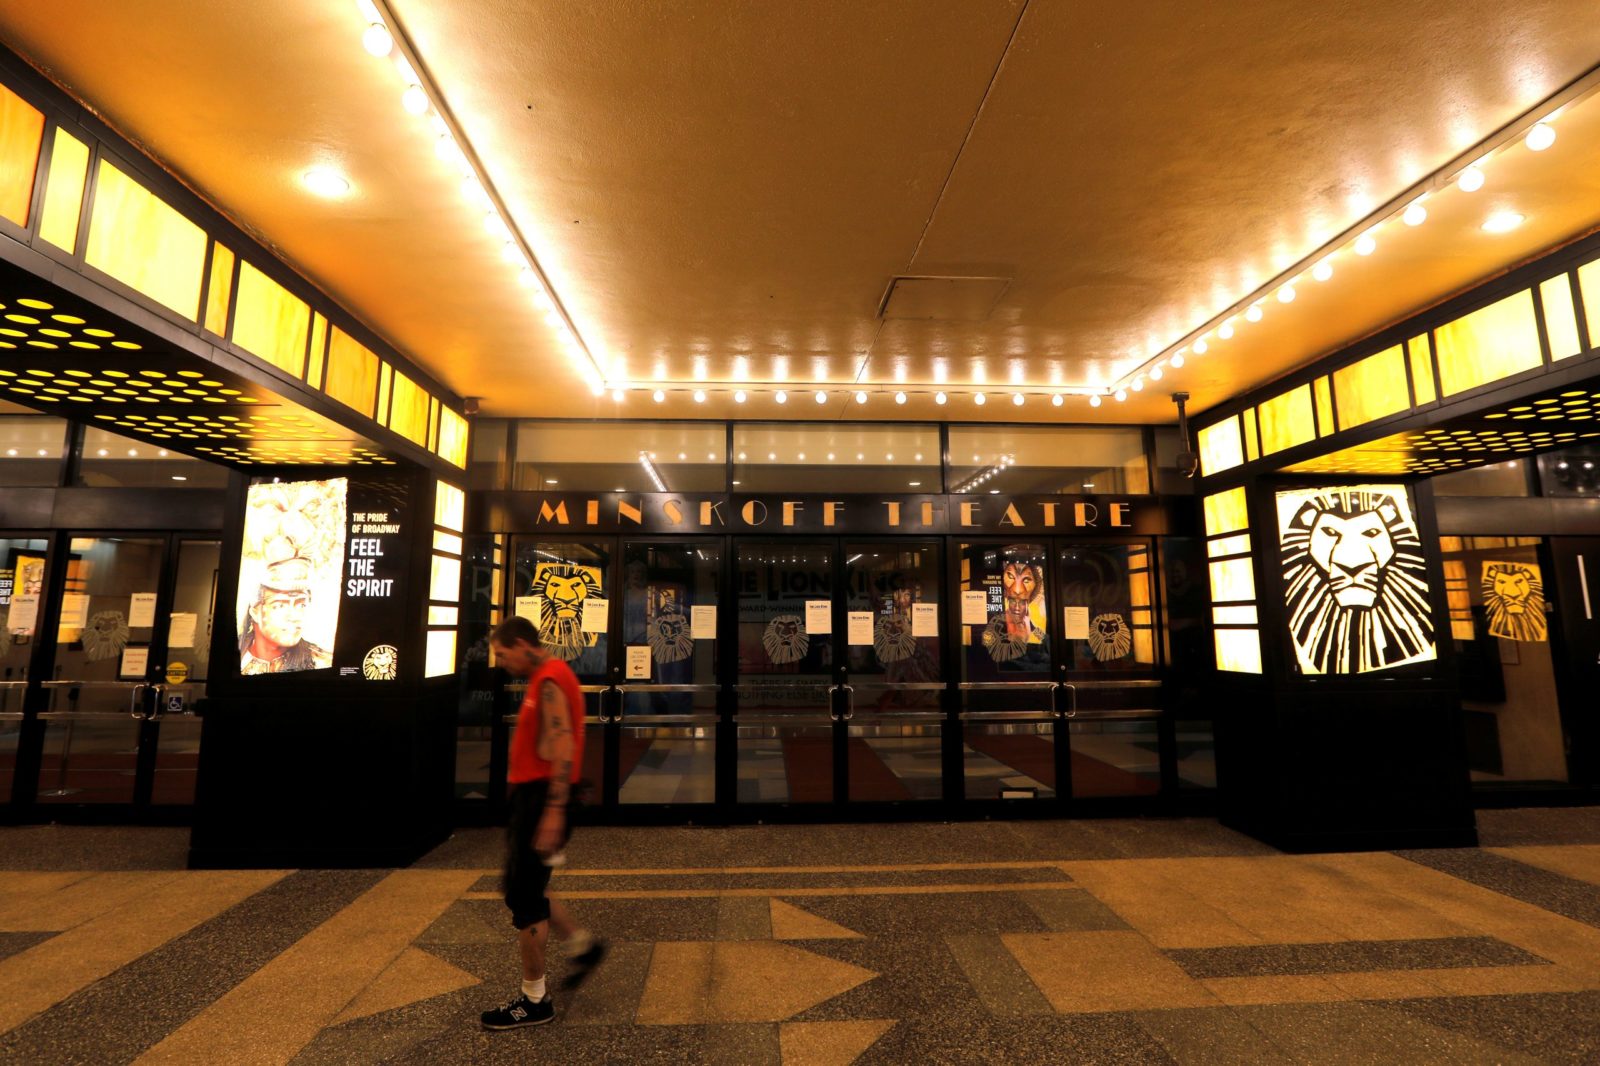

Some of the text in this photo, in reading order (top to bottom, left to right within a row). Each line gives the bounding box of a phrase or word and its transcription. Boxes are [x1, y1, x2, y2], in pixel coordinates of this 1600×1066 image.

[353, 513, 388, 522] THE PRIDE
[536, 500, 1131, 527] MINSKOFF THEATRE
[352, 525, 400, 533] OF BROADWAY
[350, 539, 384, 556] FEEL
[349, 559, 375, 576] THE
[347, 579, 394, 597] SPIRIT
[509, 1006, 528, 1021] N
